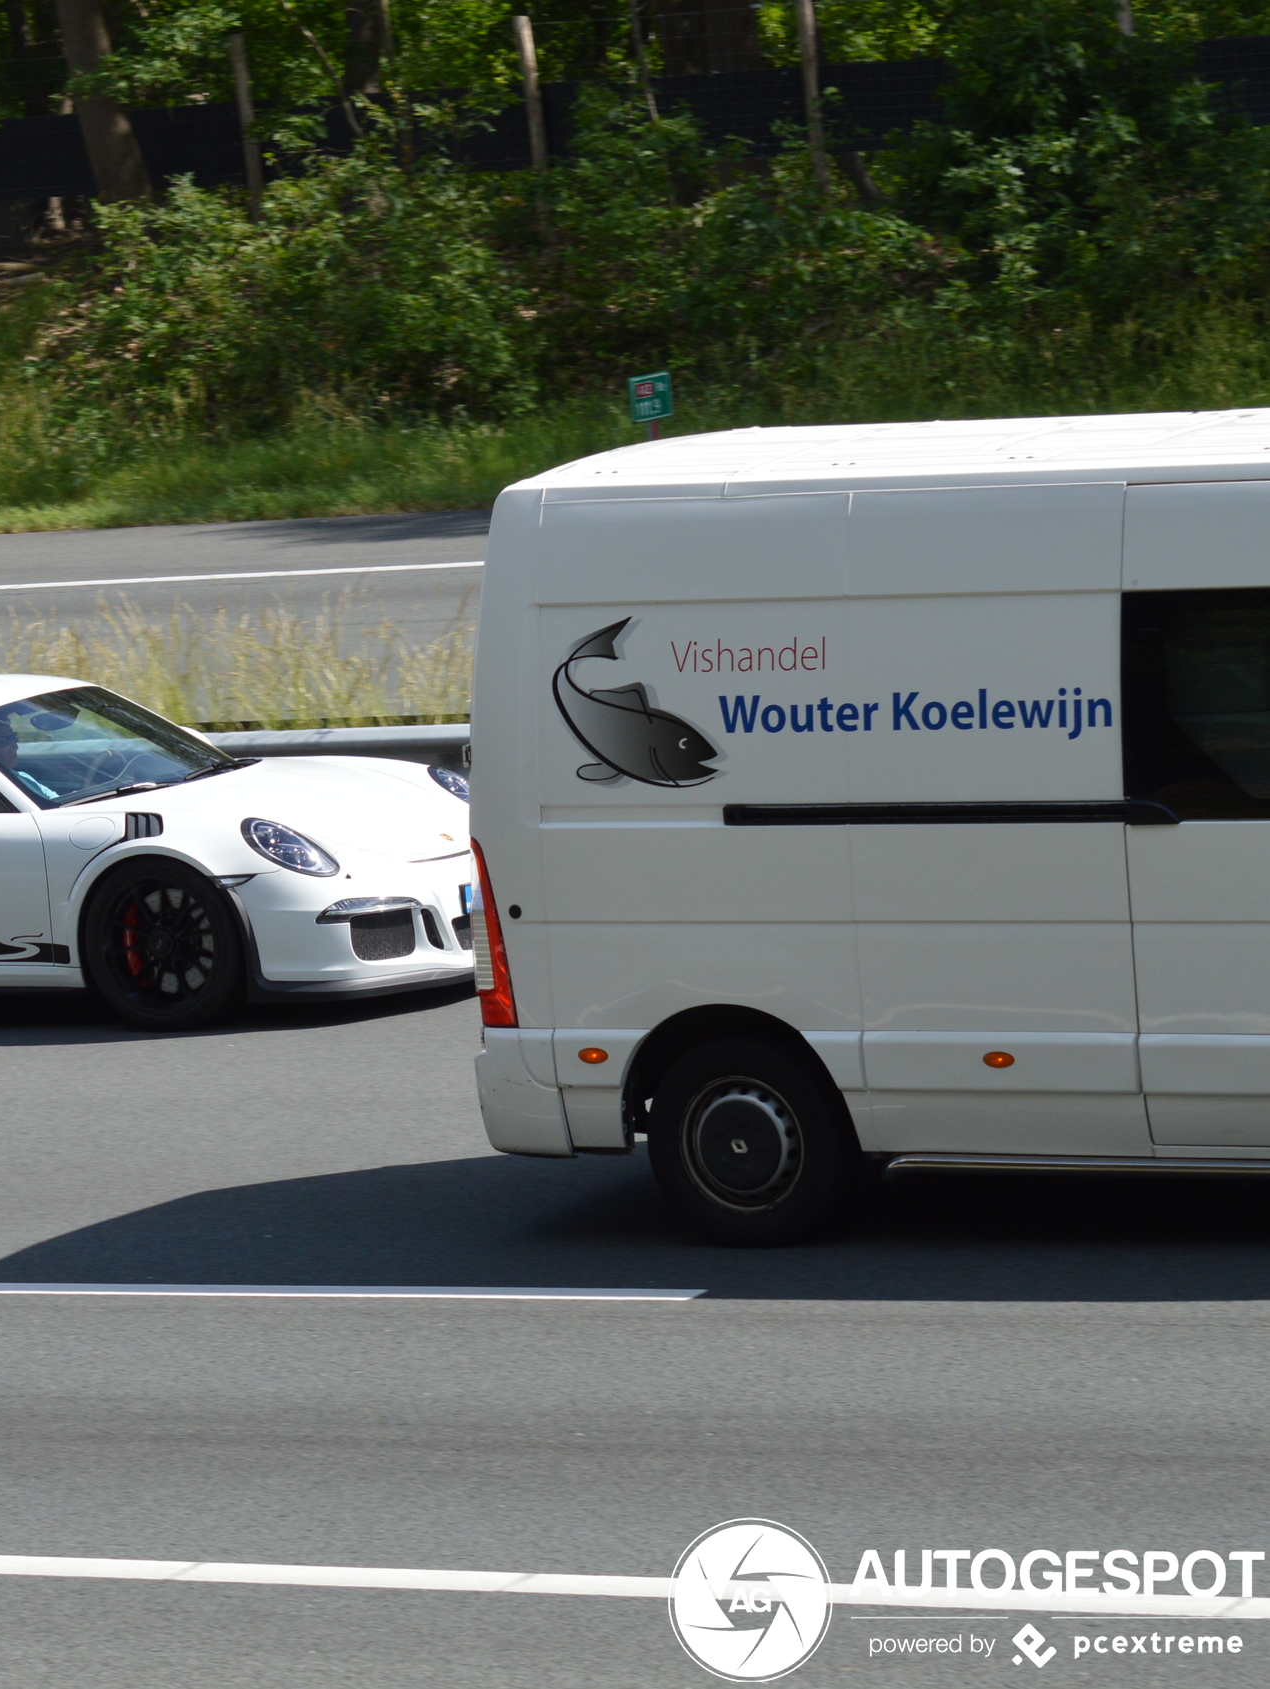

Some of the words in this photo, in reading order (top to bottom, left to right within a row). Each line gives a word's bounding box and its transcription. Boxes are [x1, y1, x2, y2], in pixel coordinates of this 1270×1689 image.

[670, 636, 827, 673] Vishandel
[718, 694, 879, 734] Wouter
[892, 687, 1113, 740] Koelewijn
